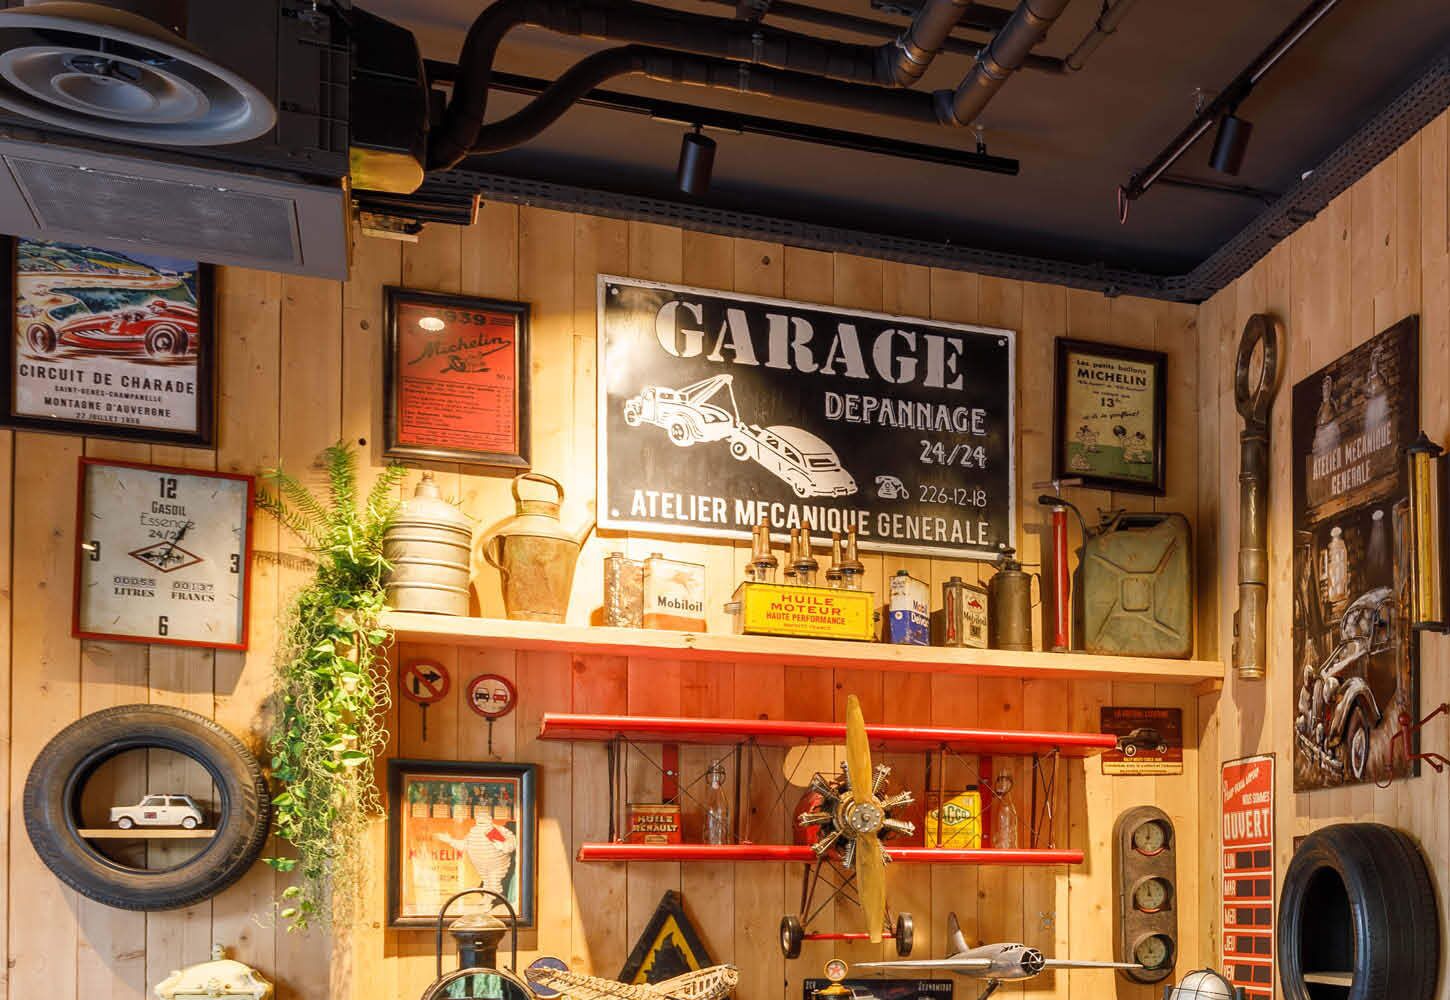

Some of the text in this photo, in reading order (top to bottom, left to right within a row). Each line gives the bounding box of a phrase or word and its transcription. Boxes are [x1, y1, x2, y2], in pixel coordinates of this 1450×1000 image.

[655, 300, 964, 391] GARAGE
[19, 364, 195, 395] CIRCUIT DE CHARADE
[1077, 368, 1147, 387] MICHELIN
[44, 397, 172, 418] MONTAGNE D'AUVERGNE
[825, 391, 987, 436] DEPANNAGE
[919, 439, 988, 470] 24/24
[159, 477, 177, 499] 12
[919, 484, 988, 508] 226-12-18
[151, 501, 186, 516] GASOIL
[630, 488, 990, 546] ATELIER MECANIQUE GENERALE
[140, 512, 196, 530] Essence
[230, 554, 241, 574] 3
[114, 587, 215, 602] LITRES FRANCS
[657, 595, 703, 612] Mobiloil
[781, 594, 834, 606] HUILE
[770, 602, 841, 615] MOTEUR
[159, 615, 169, 636] 6
[766, 612, 846, 625] HAUTE PERFORMANCE
[632, 824, 678, 832] RENAULT
[637, 815, 673, 823] HUILE
[1223, 807, 1269, 840] OUVERT
[1224, 852, 1236, 869] LUN
[1224, 935, 1235, 951] JEU
